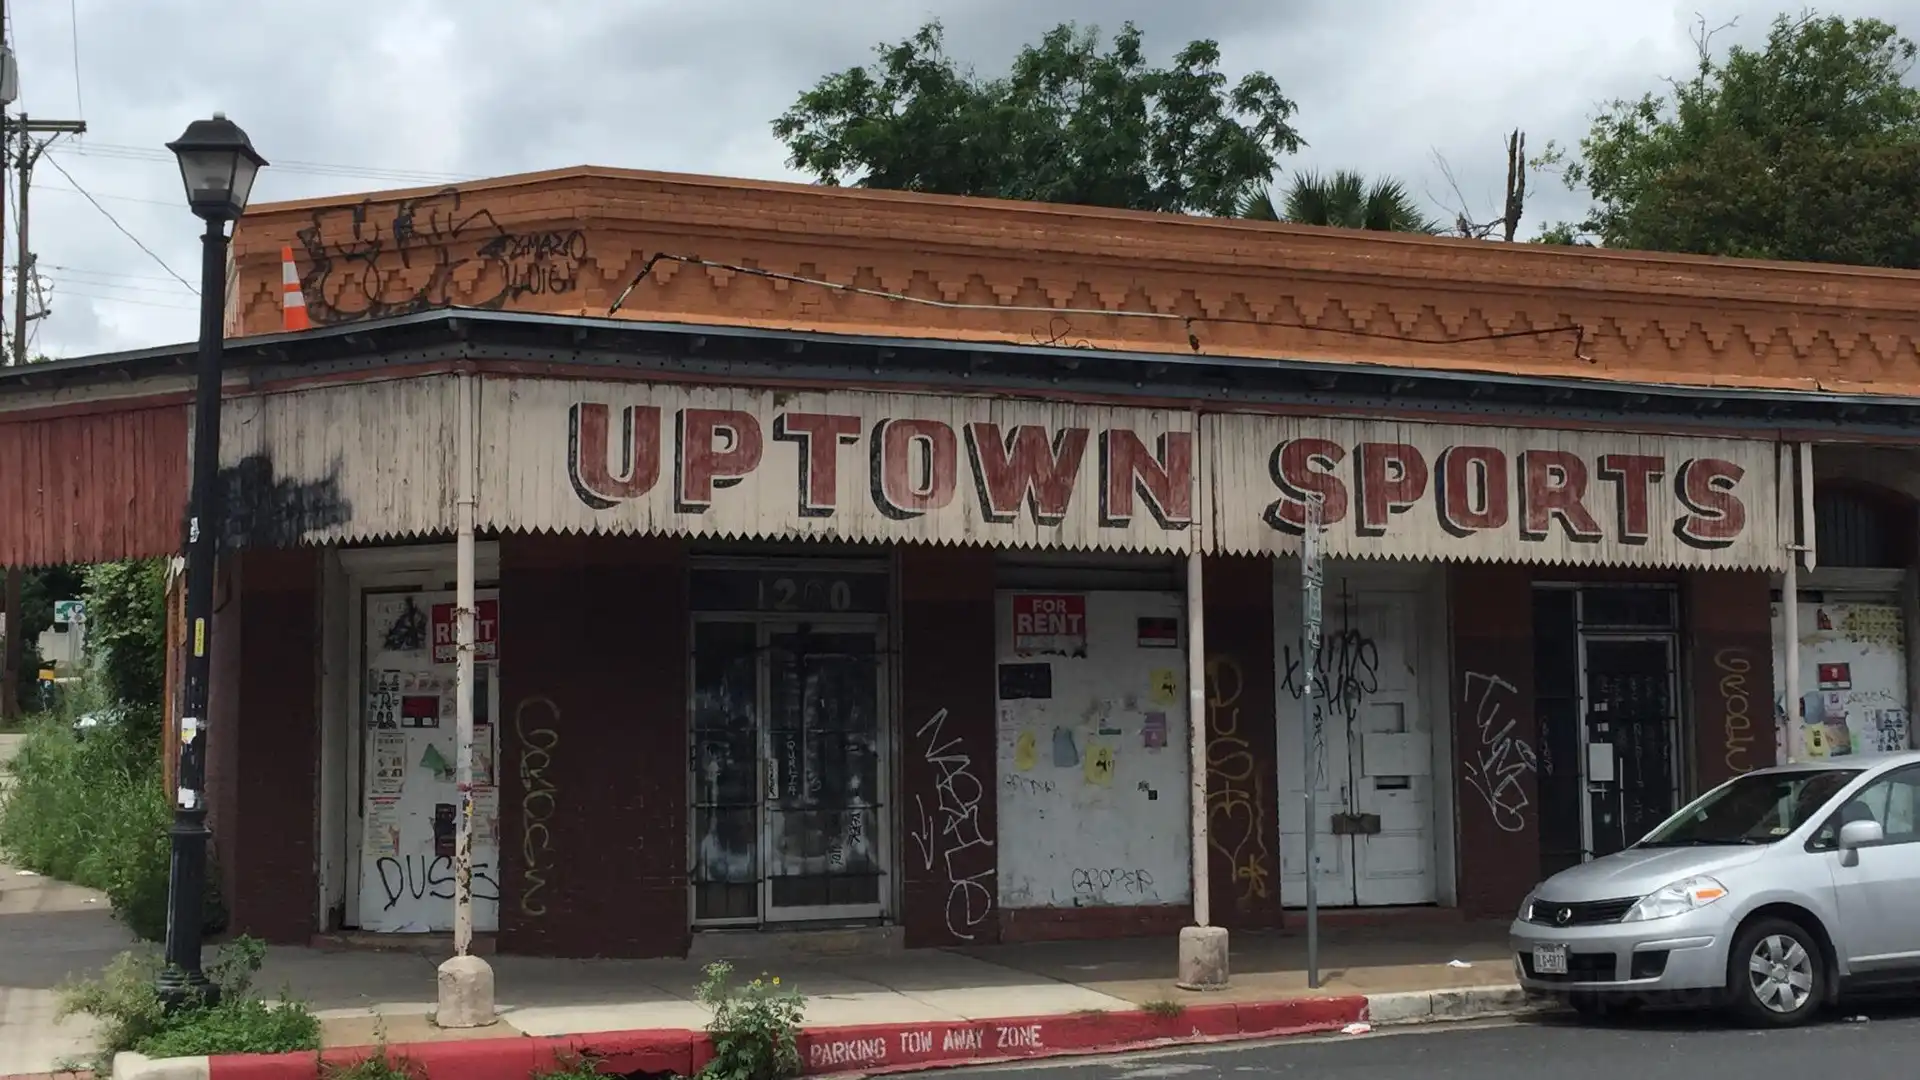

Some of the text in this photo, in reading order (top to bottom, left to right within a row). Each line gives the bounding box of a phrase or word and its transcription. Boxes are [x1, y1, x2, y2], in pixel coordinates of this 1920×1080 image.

[568, 402, 1191, 531] UPTOWN
[1263, 438, 1746, 550] SPORTS
[450, 606, 480, 620] FR
[1032, 599, 1067, 613] FOR
[1017, 614, 1083, 634] RENT
[810, 1025, 1044, 1067] PARKING TOW AWAY ZONE
